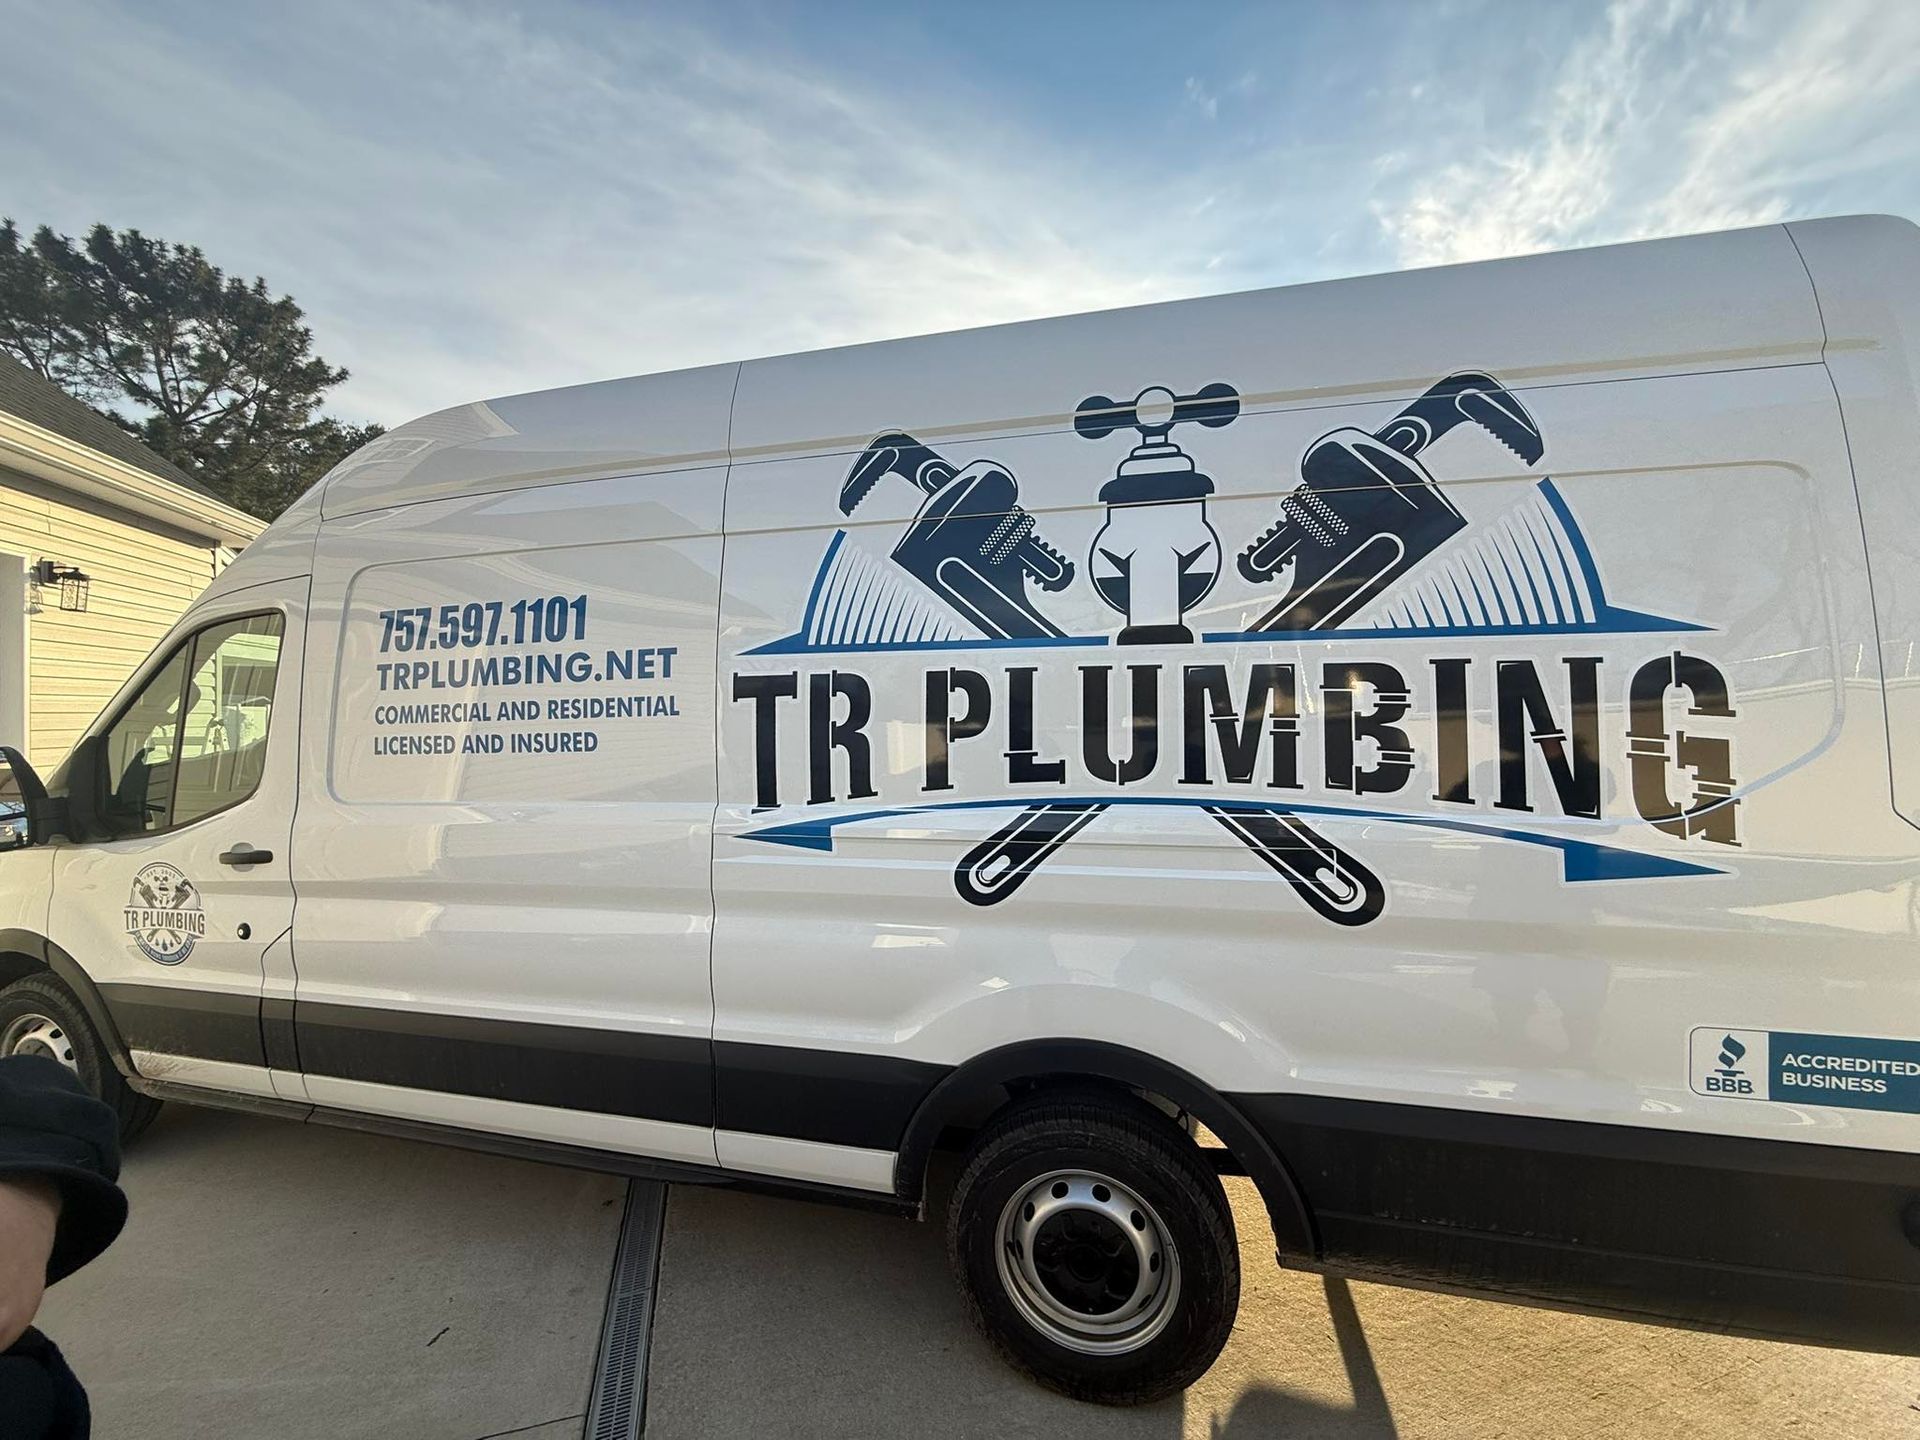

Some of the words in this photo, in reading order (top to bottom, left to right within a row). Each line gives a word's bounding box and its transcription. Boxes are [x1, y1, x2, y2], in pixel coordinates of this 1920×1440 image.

[379, 594, 588, 653] 757.597.1101
[376, 646, 678, 691] TRPLUMBING.NET
[374, 701, 491, 725] COMMERCIAL
[496, 701, 540, 721] AND
[547, 695, 680, 719] RESIDENTIAL
[374, 736, 455, 755] LICENSED
[461, 734, 504, 753] AND
[511, 731, 598, 752] INSURED
[732, 669, 878, 813] TR
[921, 650, 1742, 848] PLUMBING
[124, 910, 139, 930] TR
[142, 910, 205, 935] PLUMBING
[1781, 1053, 1920, 1077] ACCREDITED
[1705, 1076, 1754, 1094] BBB
[1782, 1072, 1888, 1094] BUSINESS
